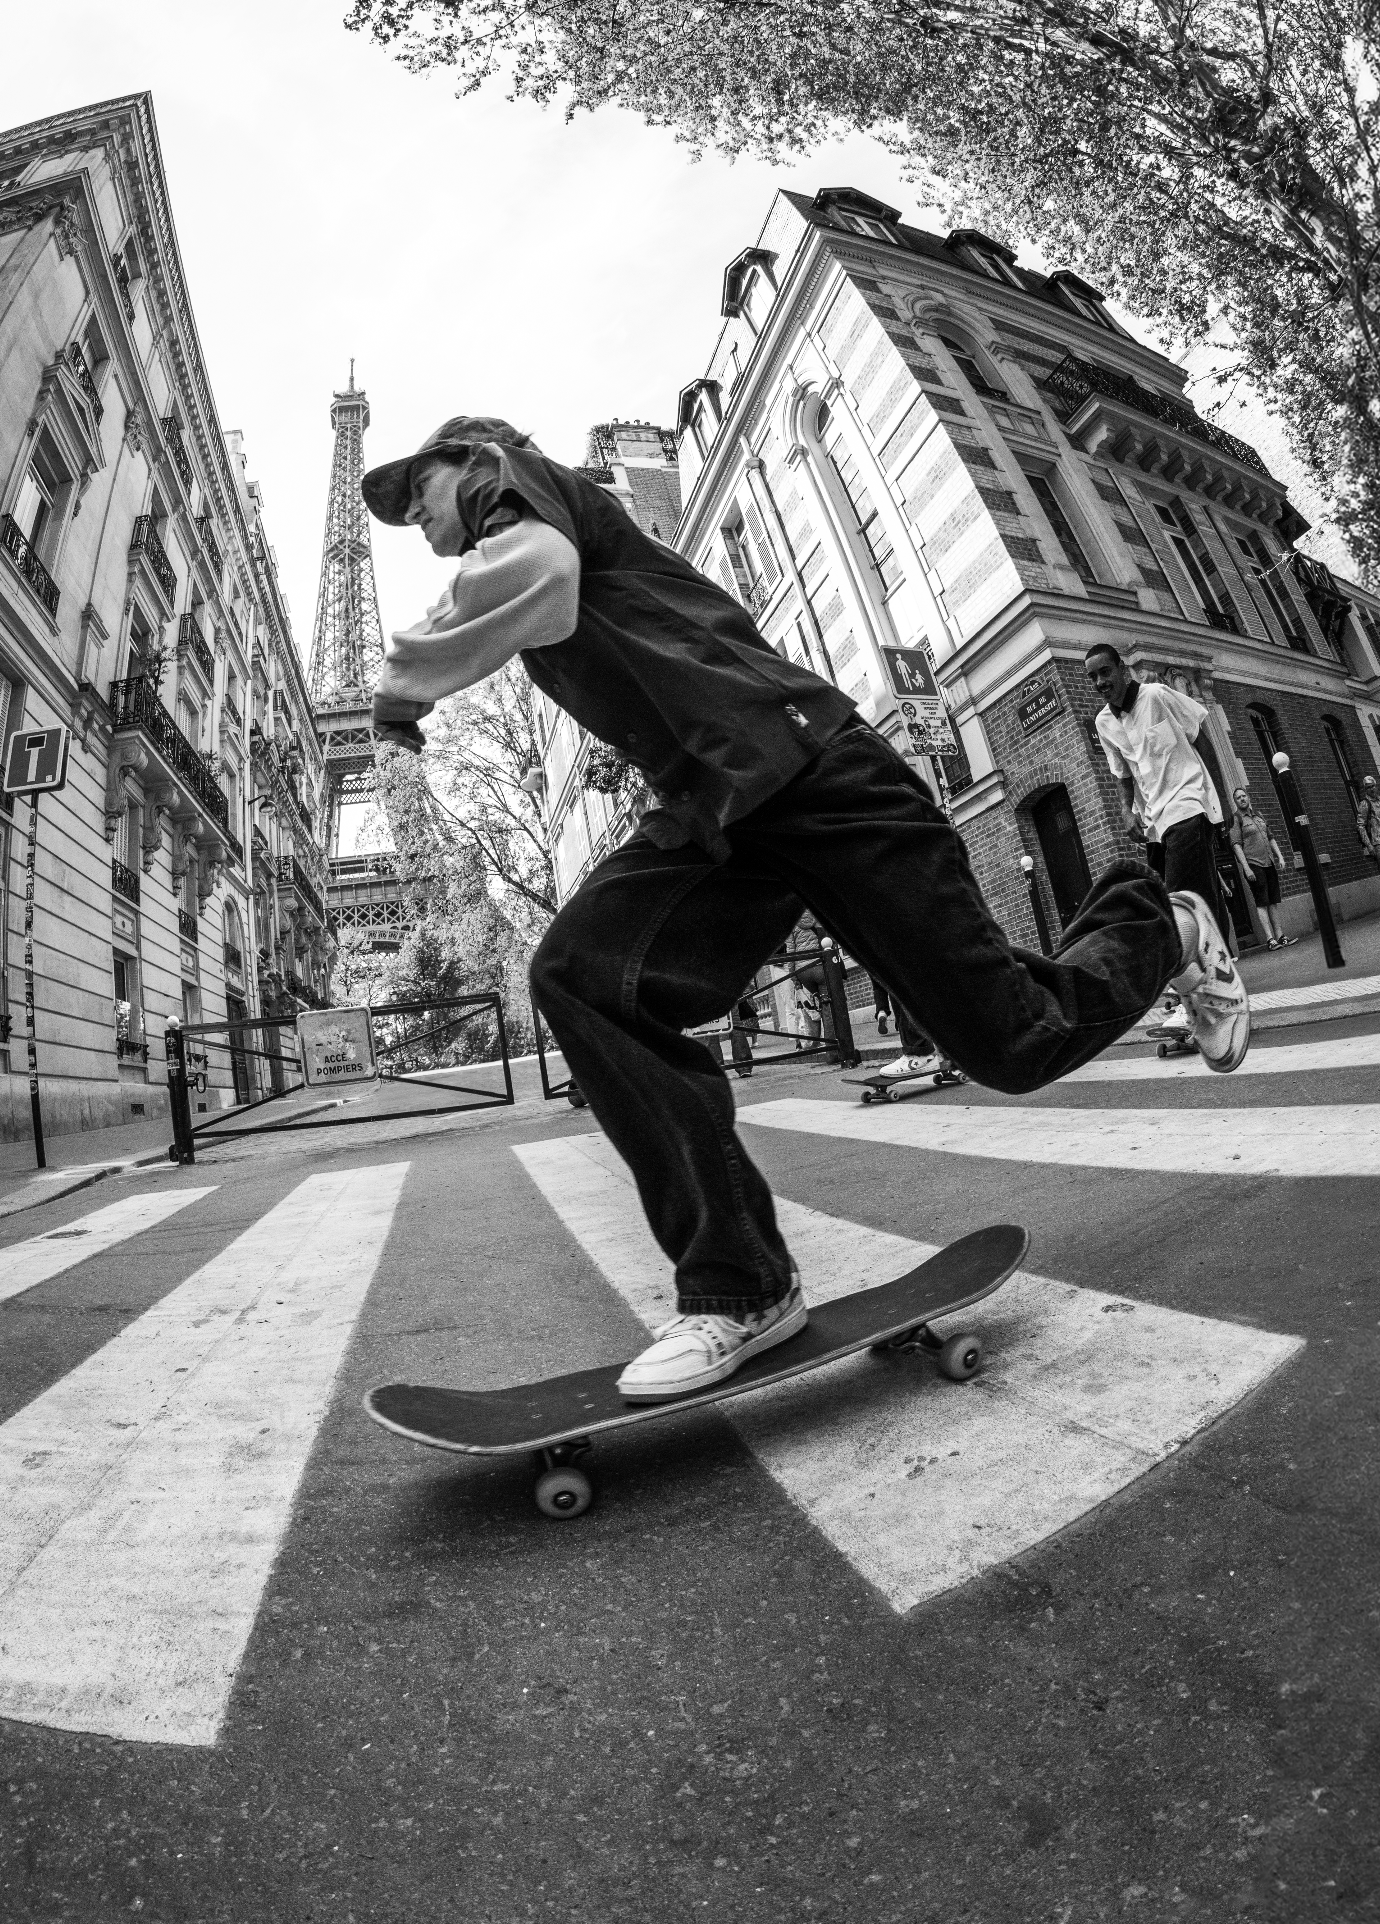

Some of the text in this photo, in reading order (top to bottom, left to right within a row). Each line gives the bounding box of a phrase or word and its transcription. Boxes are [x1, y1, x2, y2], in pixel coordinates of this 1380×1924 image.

[1026, 695, 1047, 714] RUE DE
[324, 1052, 348, 1064] ACCÈ
[316, 1063, 364, 1076] POMPIERS
